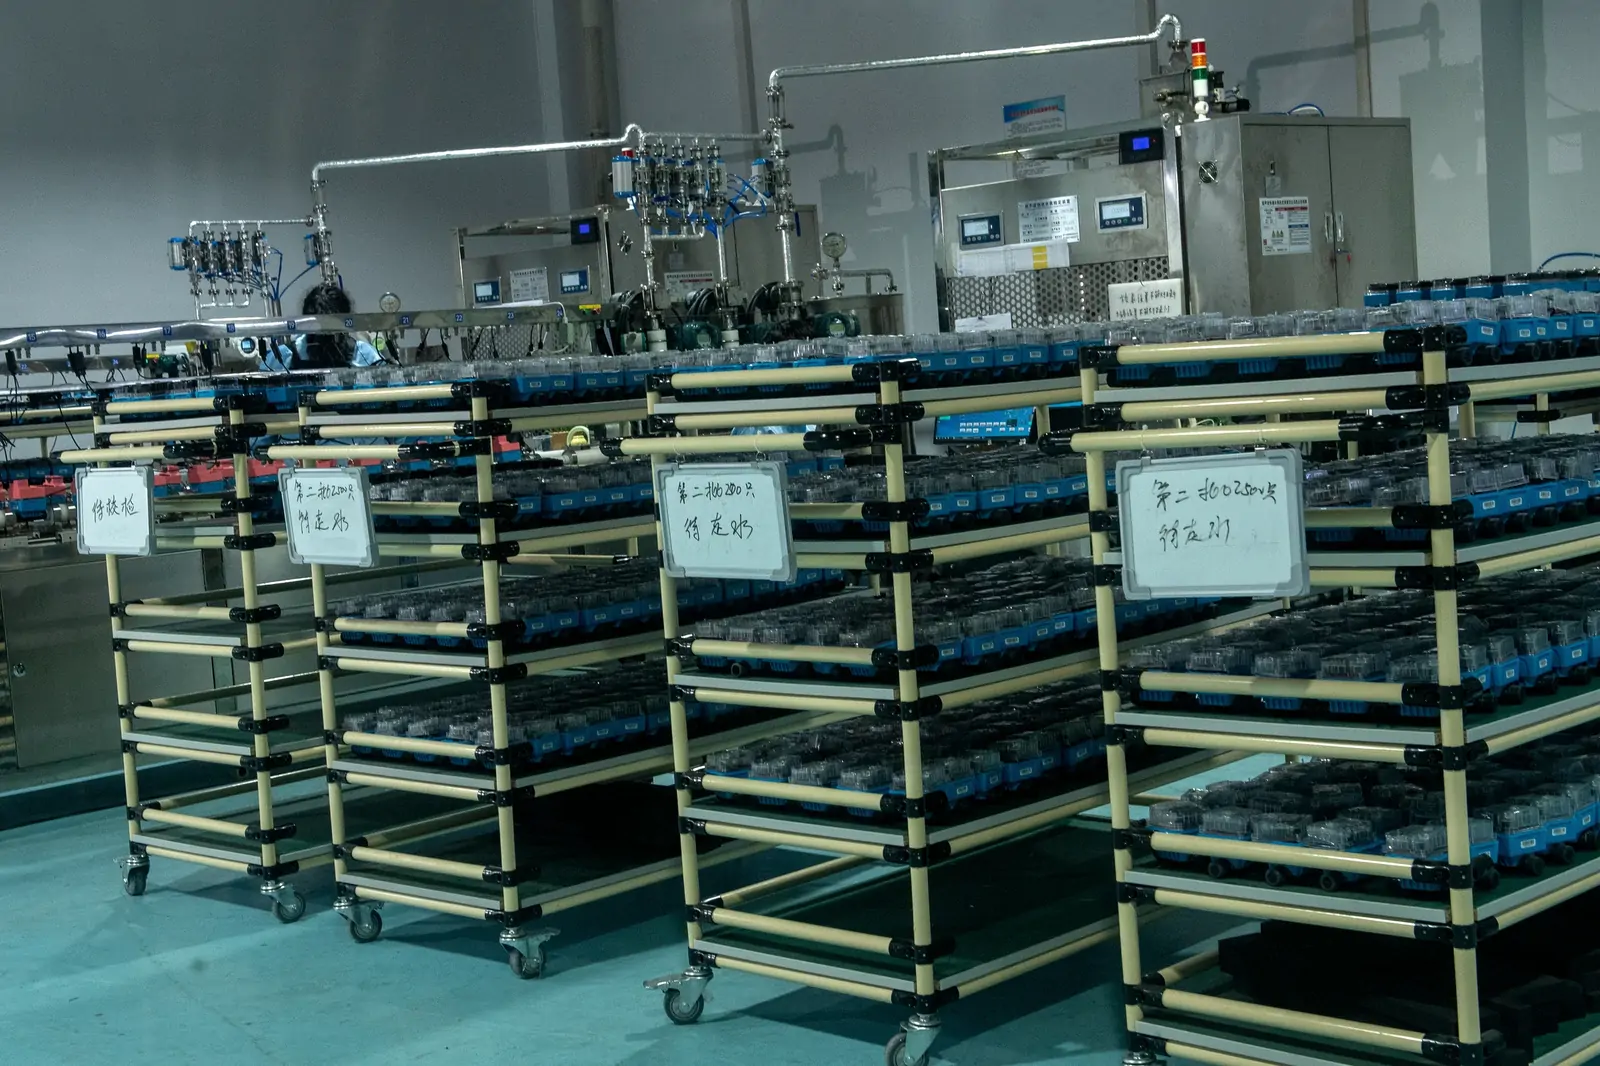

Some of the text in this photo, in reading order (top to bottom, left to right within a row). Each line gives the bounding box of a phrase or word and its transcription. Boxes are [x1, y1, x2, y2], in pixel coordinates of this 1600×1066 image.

[345, 319, 353, 327] 20
[163, 326, 171, 334] 17
[28, 332, 36, 341] 15
